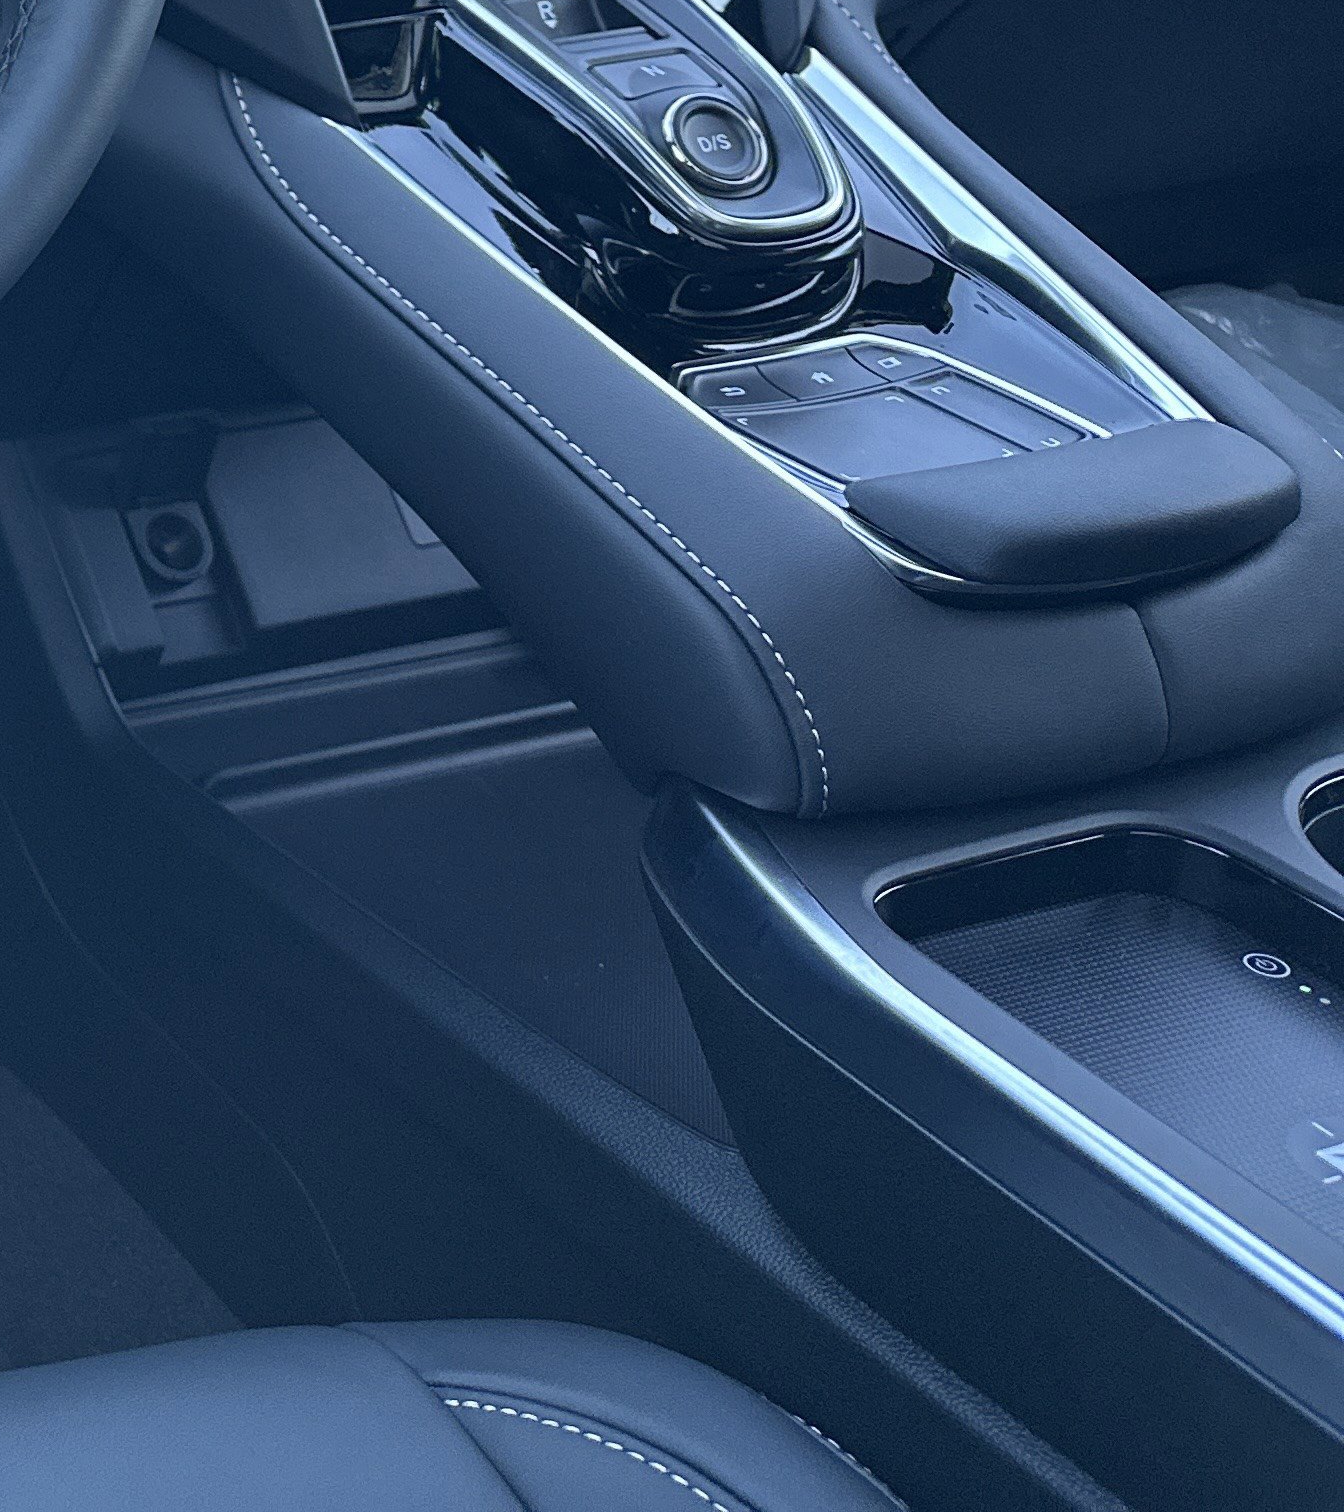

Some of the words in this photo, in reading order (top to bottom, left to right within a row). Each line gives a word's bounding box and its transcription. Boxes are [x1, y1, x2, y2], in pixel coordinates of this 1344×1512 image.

[538, 0, 555, 20] R
[639, 64, 666, 77] N
[696, 133, 733, 152] D/S
